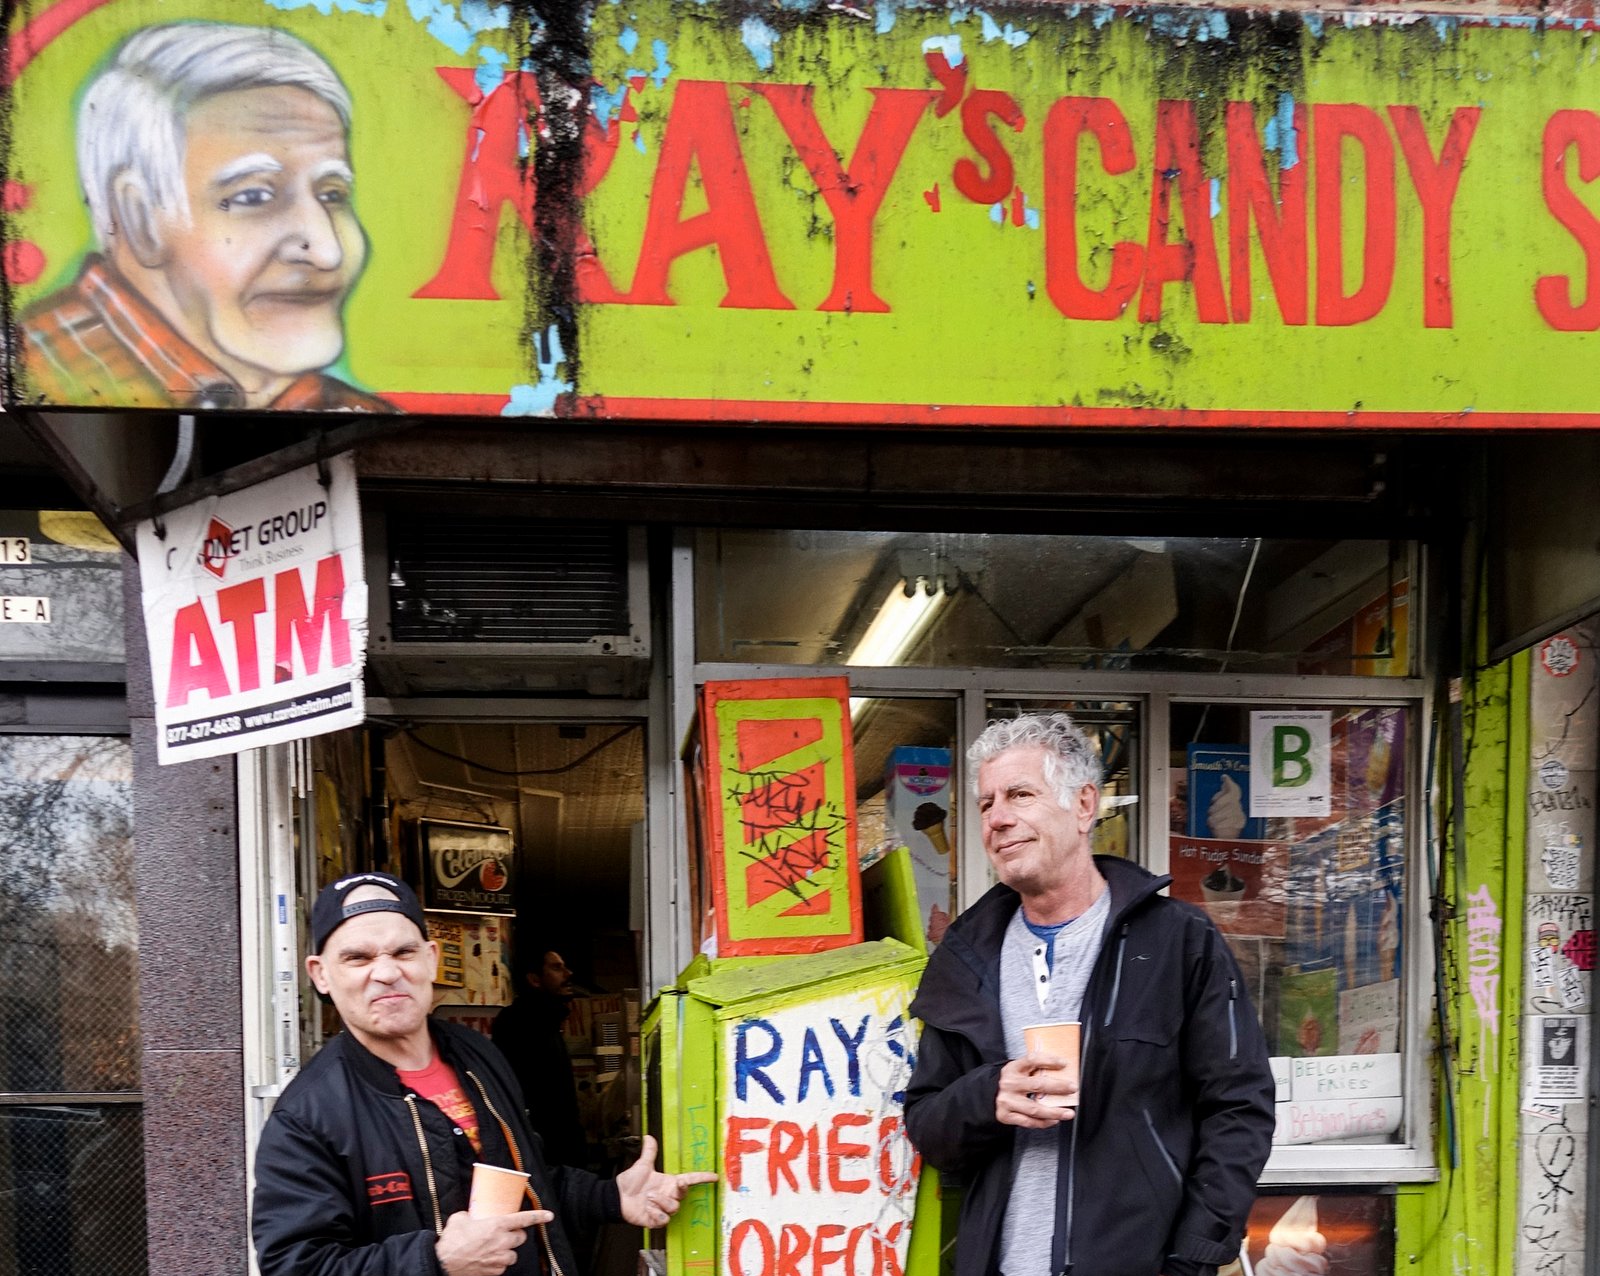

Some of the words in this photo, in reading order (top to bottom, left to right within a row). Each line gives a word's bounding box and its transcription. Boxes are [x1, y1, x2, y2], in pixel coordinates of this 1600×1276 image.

[1042, 96, 1482, 328] CANDY
[257, 501, 327, 546] GROUP
[165, 553, 353, 709] ATM
[1272, 725, 1312, 788] B
[1199, 846, 1230, 863] Fudge
[1231, 848, 1270, 865] Sunda
[725, 1113, 921, 1197] FRIED
